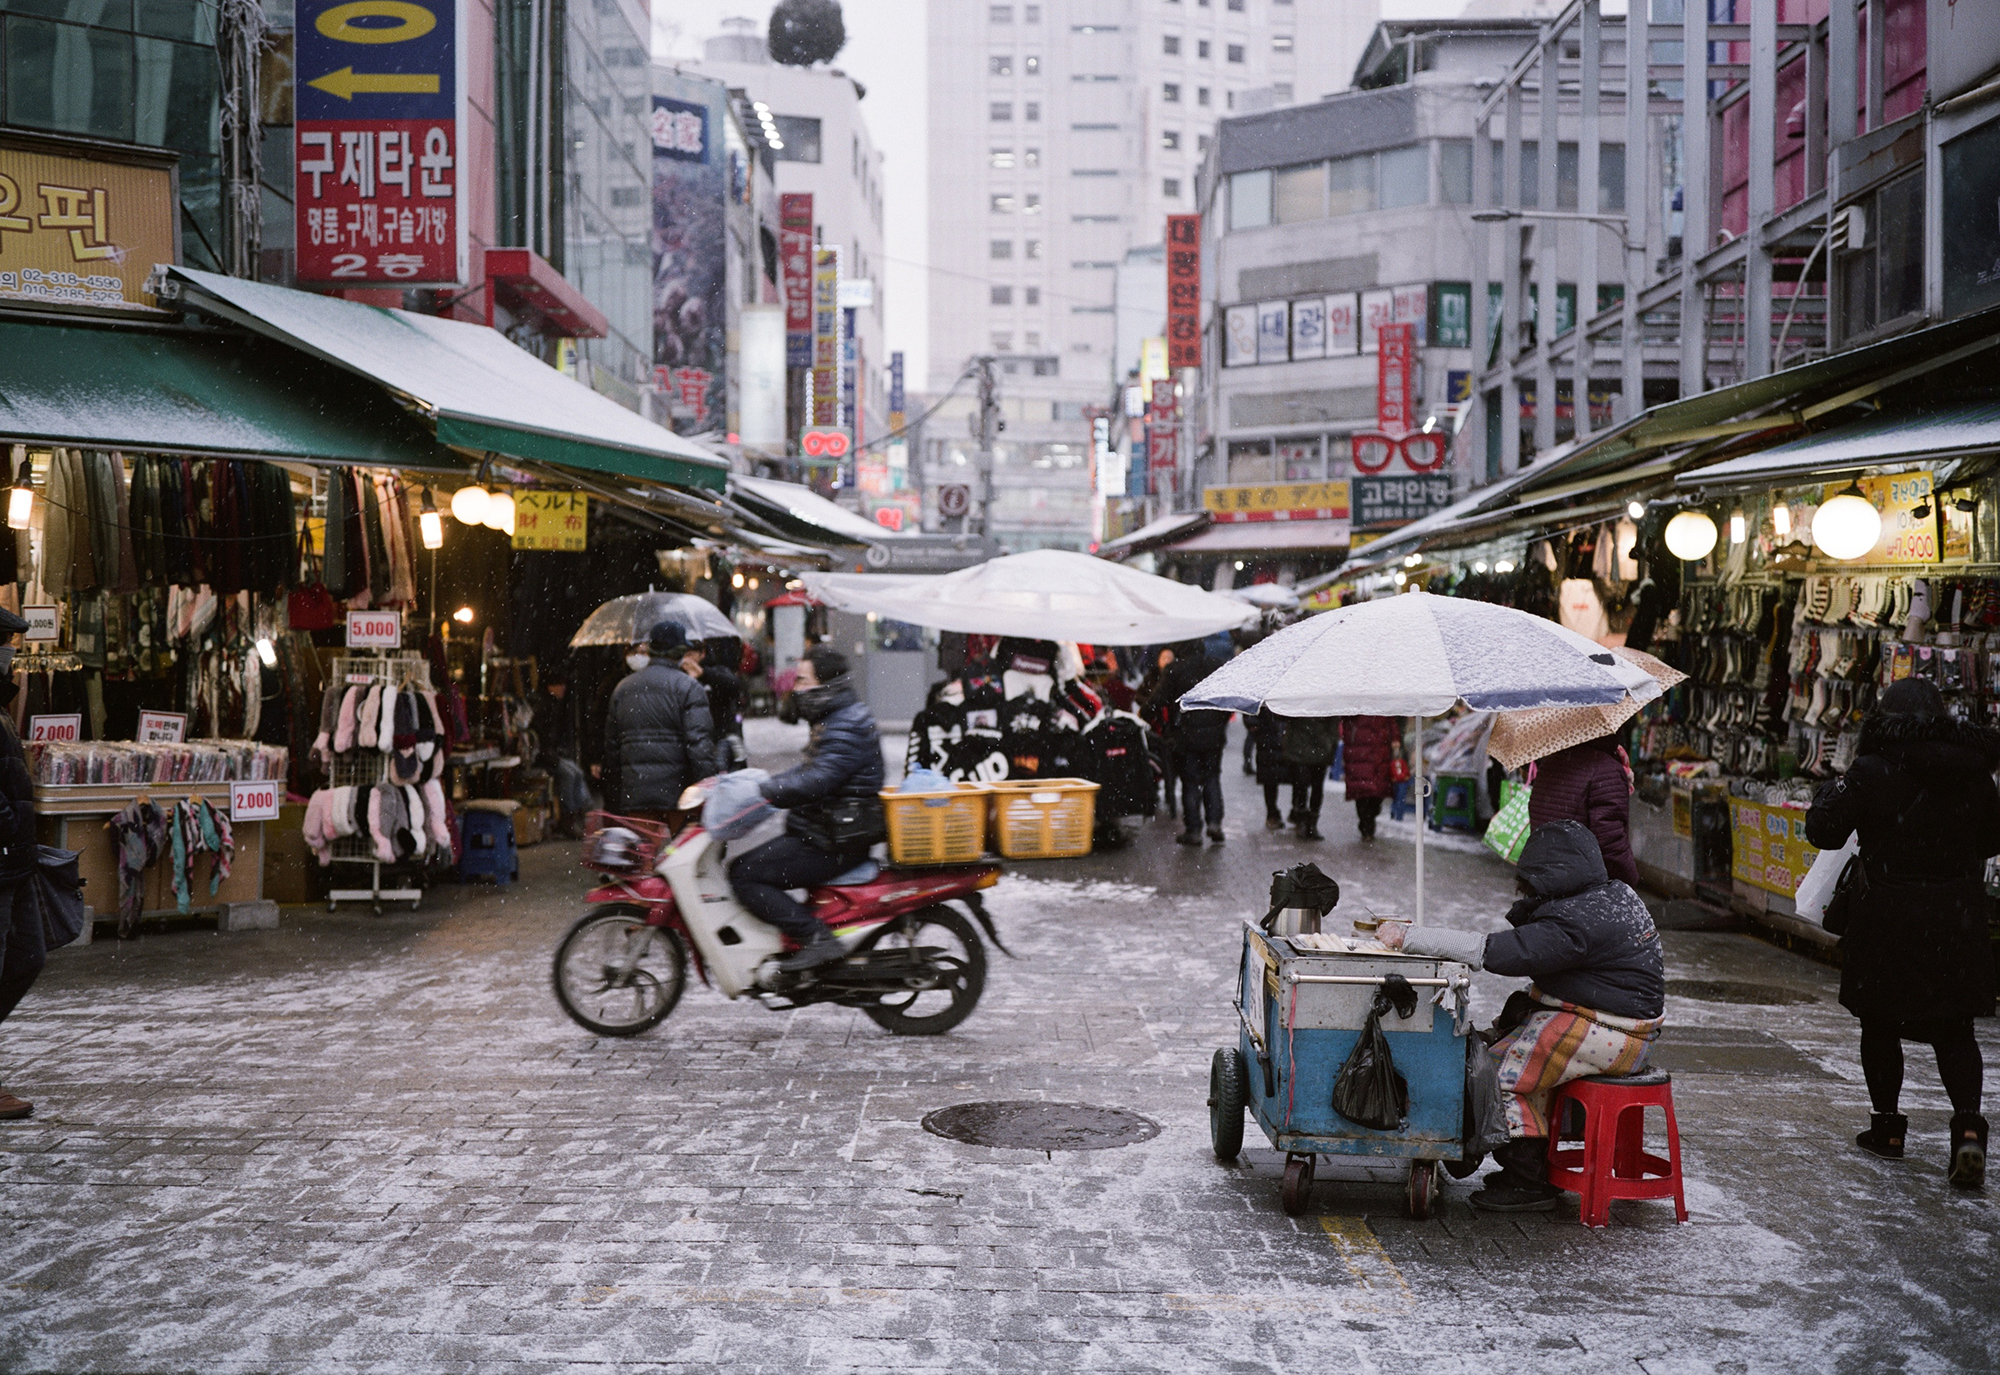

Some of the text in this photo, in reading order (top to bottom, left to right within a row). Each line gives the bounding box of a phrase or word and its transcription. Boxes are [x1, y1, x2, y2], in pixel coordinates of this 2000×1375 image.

[301, 127, 453, 198] 구제타운
[22, 269, 122, 290] 02-318-4590
[1172, 219, 1196, 340] 대광안경
[520, 494, 583, 512] ベルト
[1361, 480, 1448, 504] 고려안경
[146, 719, 179, 731] 도매판매
